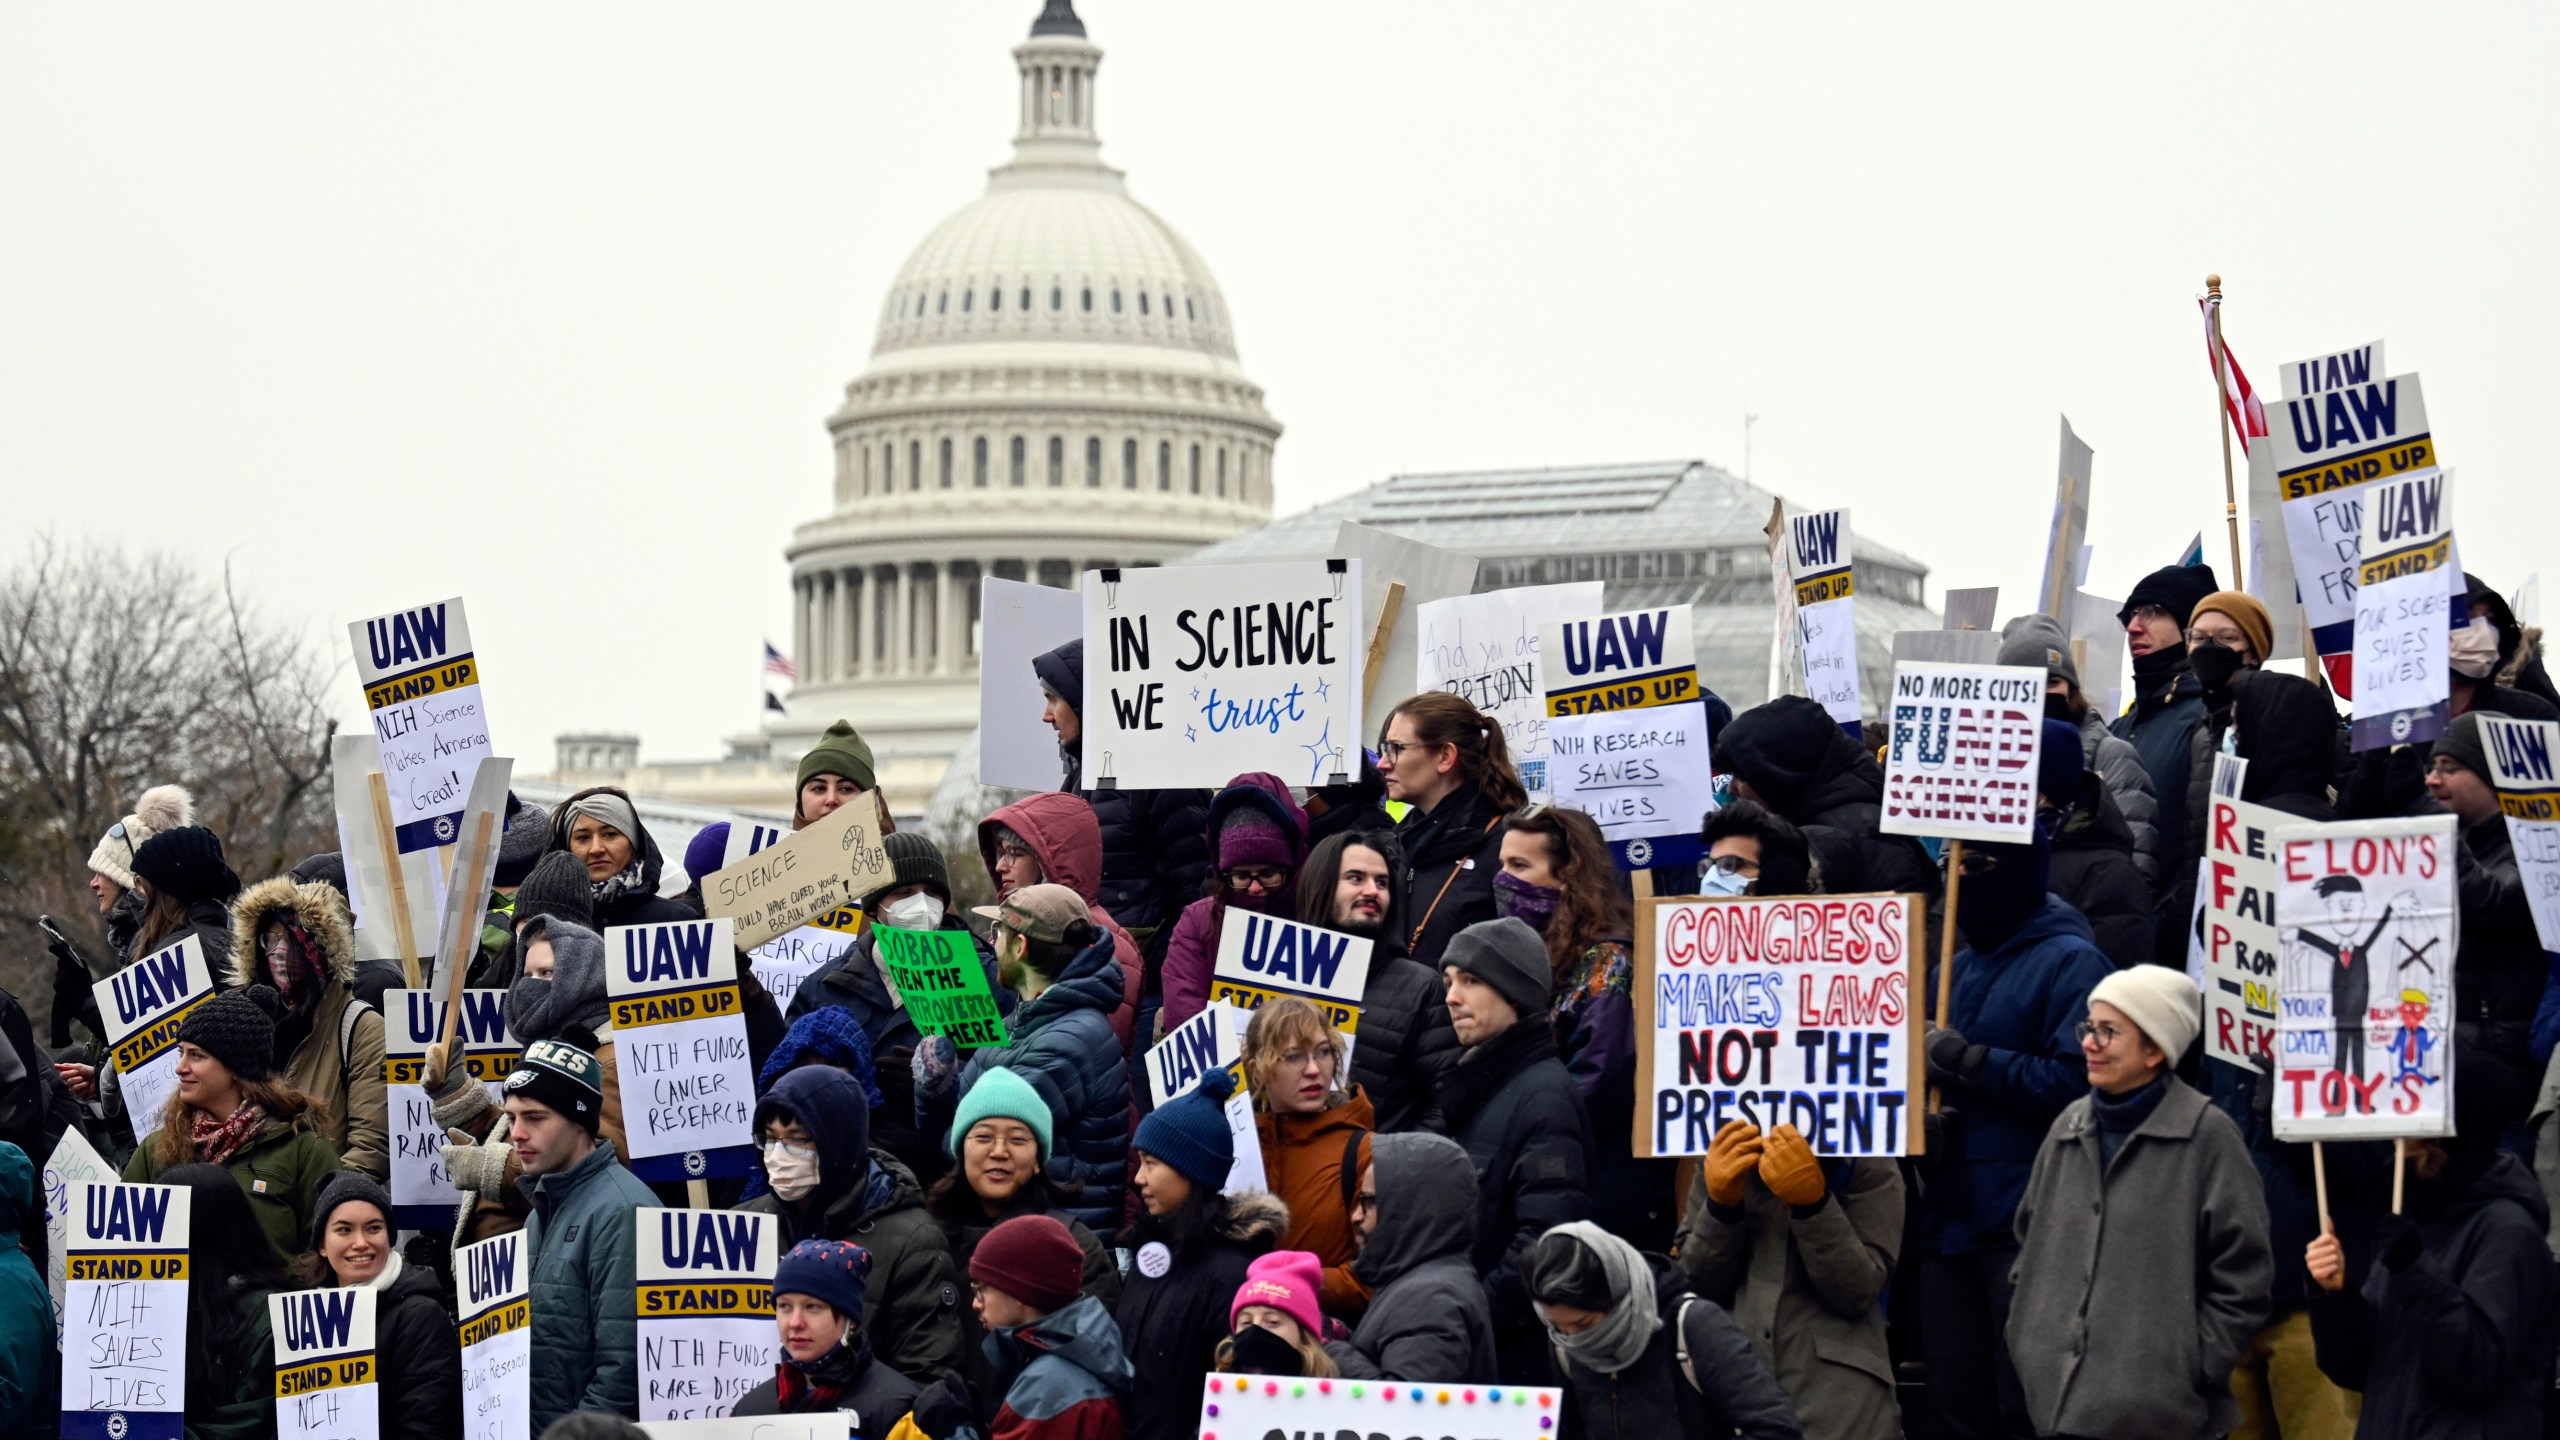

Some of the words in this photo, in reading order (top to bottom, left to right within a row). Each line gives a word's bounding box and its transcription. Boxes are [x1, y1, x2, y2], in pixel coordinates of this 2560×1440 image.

[2298, 346, 2371, 395] UAW
[2288, 380, 2396, 454] UAW
[2289, 459, 2381, 499] STAND
[2390, 446, 2427, 472] UP
[2378, 474, 2444, 543] UAW
[1794, 511, 1839, 567] UAW
[2363, 553, 2427, 585] STAND
[2433, 543, 2448, 569] UP
[1798, 582, 1829, 607] STAND
[1832, 577, 1849, 597] UP
[2319, 567, 2358, 605] FR
[367, 603, 446, 670] UAW
[1109, 614, 1150, 672] IN
[1175, 598, 1336, 672] SCIENCE
[2357, 607, 2389, 634] OUR
[1420, 617, 1468, 677] And
[1516, 615, 1540, 656] de
[1563, 611, 1668, 676] UAW
[2371, 628, 2427, 662] SAVES
[371, 675, 435, 709] STAND
[442, 664, 471, 688] UP
[1446, 662, 1533, 711] PRISON
[1898, 675, 1924, 697] NO
[1929, 677, 1982, 700] MORE
[1989, 679, 2038, 703] CUTS!
[2368, 657, 2427, 691] LIVES
[1111, 683, 1164, 731] WE
[1201, 683, 1305, 734] trust
[1554, 686, 1645, 717] STAND
[1650, 677, 1690, 707] UP
[377, 706, 418, 743] NIH
[423, 701, 475, 727] Science
[1553, 736, 1584, 757] NIH
[1594, 730, 1686, 753] RESEARCH
[1891, 705, 2034, 774] FUND
[383, 752, 425, 777] Makes
[433, 733, 488, 759] America
[1578, 758, 1659, 784] SAVES
[2486, 720, 2554, 781] UAW
[411, 771, 461, 810] Great!
[1888, 774, 2030, 826] SCIENCE!
[2503, 798, 2553, 818] STAND
[2215, 803, 2276, 865] RE
[719, 850, 797, 906] SCIENCE
[2285, 835, 2437, 881] ELON'S
[766, 898, 787, 917] HAVE
[791, 885, 814, 904] CURED
[817, 874, 840, 893] YOUR
[769, 907, 804, 932] BRAIN
[809, 890, 836, 912] WORM
[2212, 861, 2275, 927] FAI
[817, 911, 854, 929] UP
[1665, 901, 1902, 967] CONGRESS
[625, 922, 713, 983] UAW
[1242, 915, 1350, 989] UAW
[111, 944, 189, 1024] UAW
[1219, 987, 1270, 1009] STA
[1657, 971, 1784, 1028] MAKES
[1800, 971, 1907, 1027] LAWS
[408, 992, 507, 1043] UAW
[617, 997, 695, 1025] STAND
[702, 991, 733, 1013] UP
[2281, 998, 2326, 1018] YOUR
[119, 1024, 179, 1067] STAND
[943, 1019, 1000, 1045] HERE
[1158, 1009, 1219, 1098] UAW
[2285, 1029, 2329, 1055] DATA
[395, 1062, 485, 1081] STD
[527, 1041, 589, 1075] GLES
[632, 1042, 678, 1077] NIH
[694, 1036, 746, 1064] FUNDS
[1679, 1029, 1778, 1086] NOT
[1796, 1030, 1890, 1087] THE
[127, 1070, 160, 1104] THE
[164, 1060, 180, 1080] CU
[654, 1073, 730, 1106] CANCER
[2282, 1069, 2424, 1119] TOYS
[407, 1099, 432, 1131] NI
[649, 1101, 747, 1135] RESEARCH
[1657, 1089, 1906, 1153] PRESIDENT
[87, 1184, 171, 1243] UAW
[662, 1211, 760, 1273] UAW
[72, 1259, 142, 1280] STAND
[150, 1258, 182, 1279] UP
[468, 1235, 517, 1305] UAW
[88, 1282, 152, 1329] NIH
[282, 1291, 357, 1352] UAW
[645, 1289, 739, 1312] STAND
[464, 1316, 501, 1347] STAND
[506, 1305, 526, 1327] UP
[90, 1334, 164, 1366] SAVES
[646, 1336, 704, 1372] NIH
[718, 1340, 769, 1369] FUNDS
[88, 1375, 166, 1410] LIVES
[281, 1367, 332, 1394] STAND
[340, 1361, 369, 1384] UP
[649, 1378, 702, 1402] RARE
[298, 1393, 341, 1432] NIH
